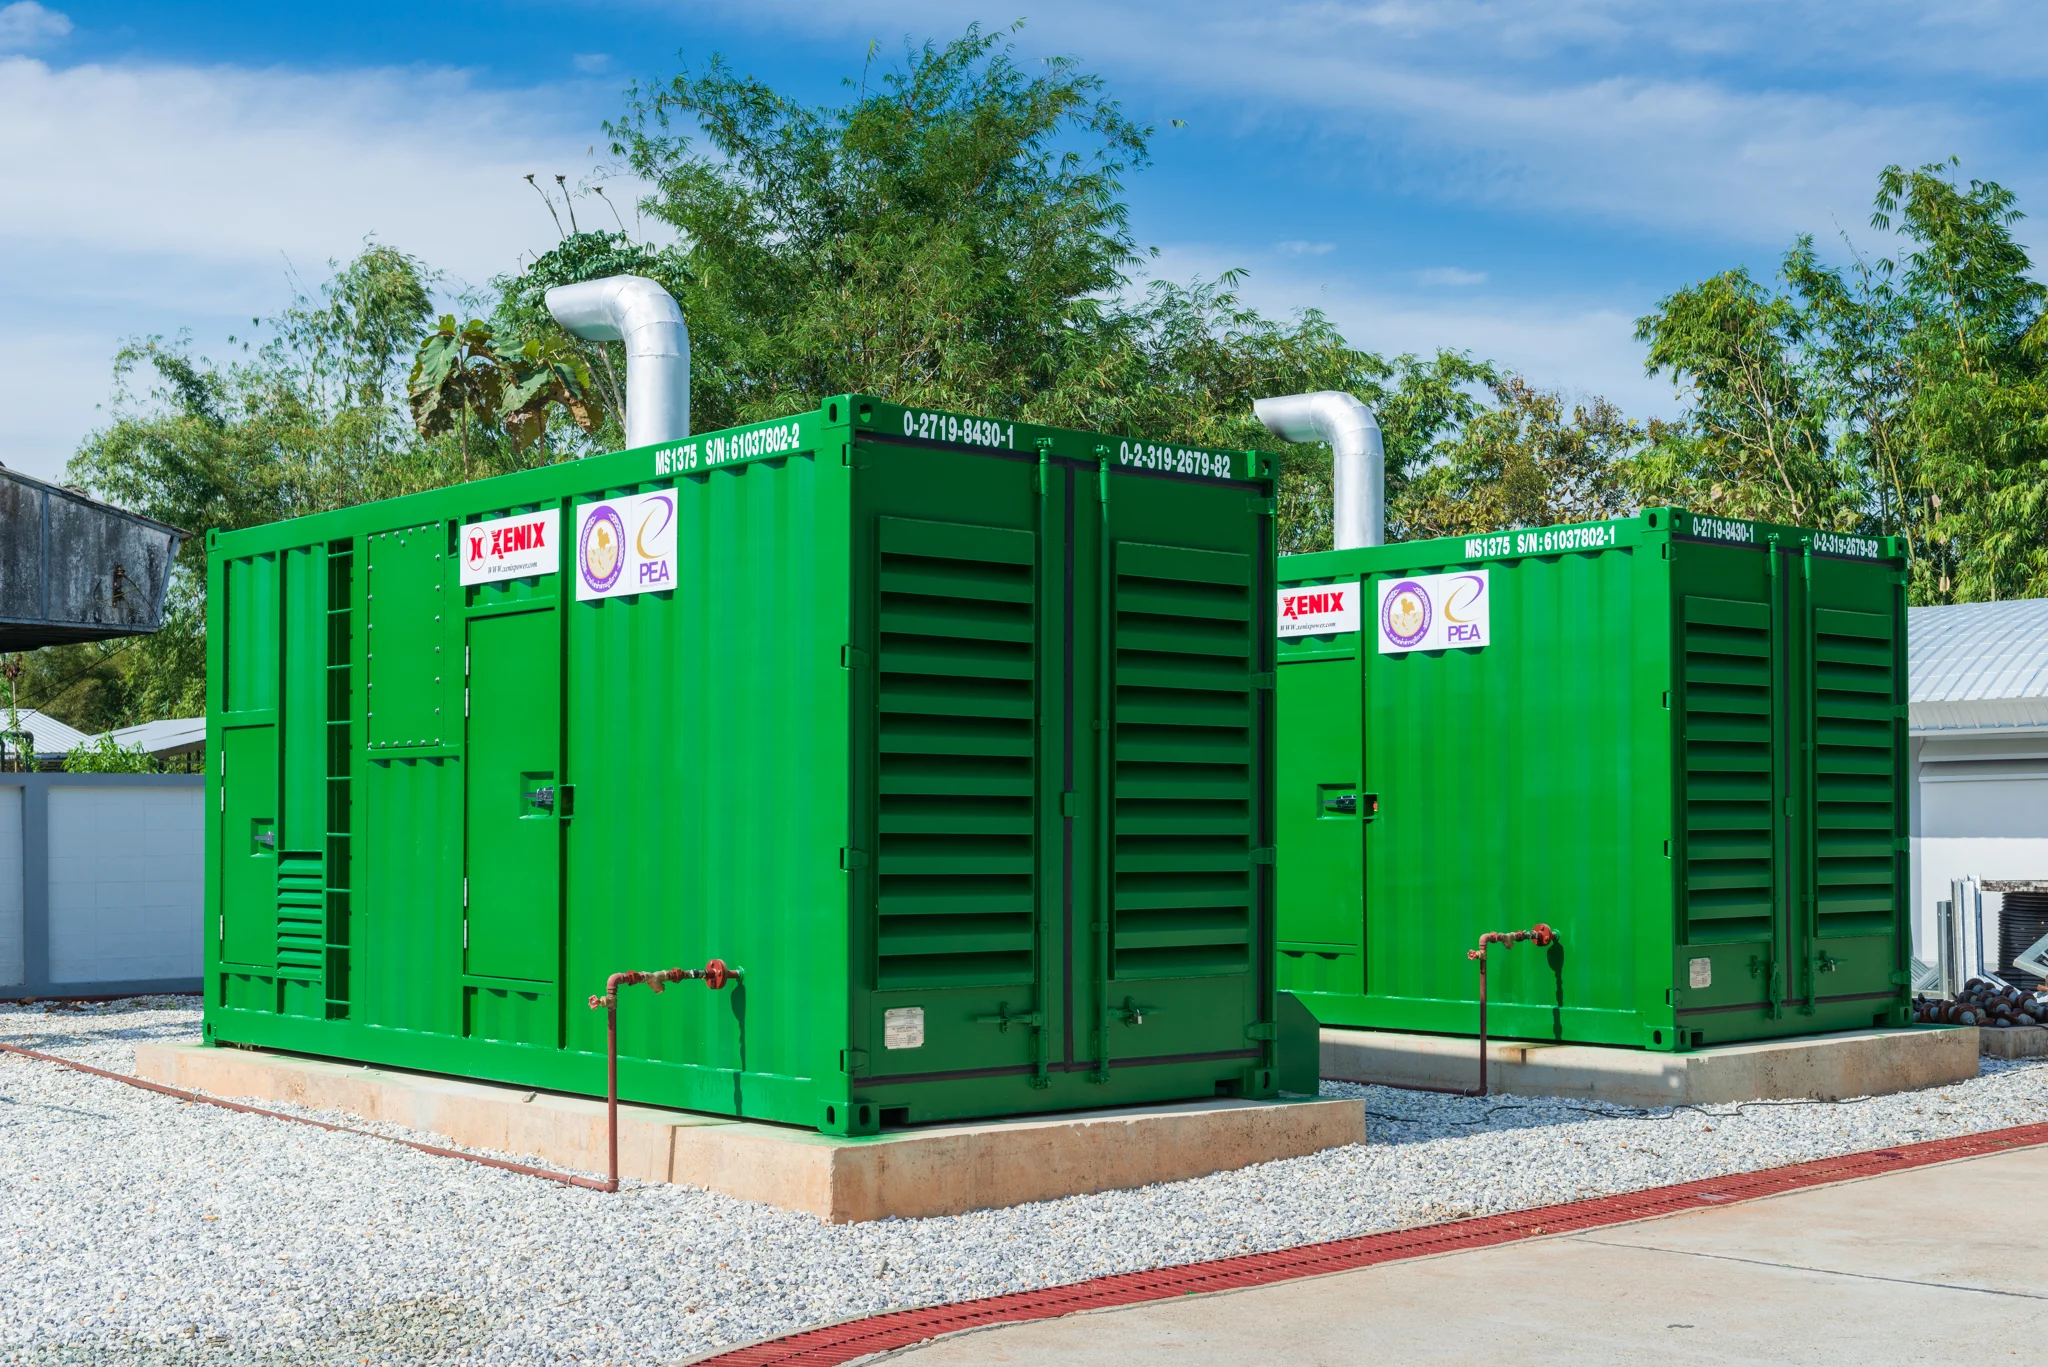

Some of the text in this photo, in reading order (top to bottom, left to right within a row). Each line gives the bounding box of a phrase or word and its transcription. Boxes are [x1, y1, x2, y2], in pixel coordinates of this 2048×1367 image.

[903, 410, 1014, 449] 0-2719-8430-1
[655, 422, 800, 476] MS1375 S/N:61037802-2
[1119, 441, 1232, 479] 0-2-319-2679-82
[490, 521, 545, 560] XENIX
[1465, 525, 1616, 559] MS1375 S/N:61037802-1
[1692, 516, 1755, 543] 0-2719-8430-1
[639, 560, 670, 584] PEA
[1282, 591, 1344, 620] XENIX
[1447, 623, 1481, 642] PEA
